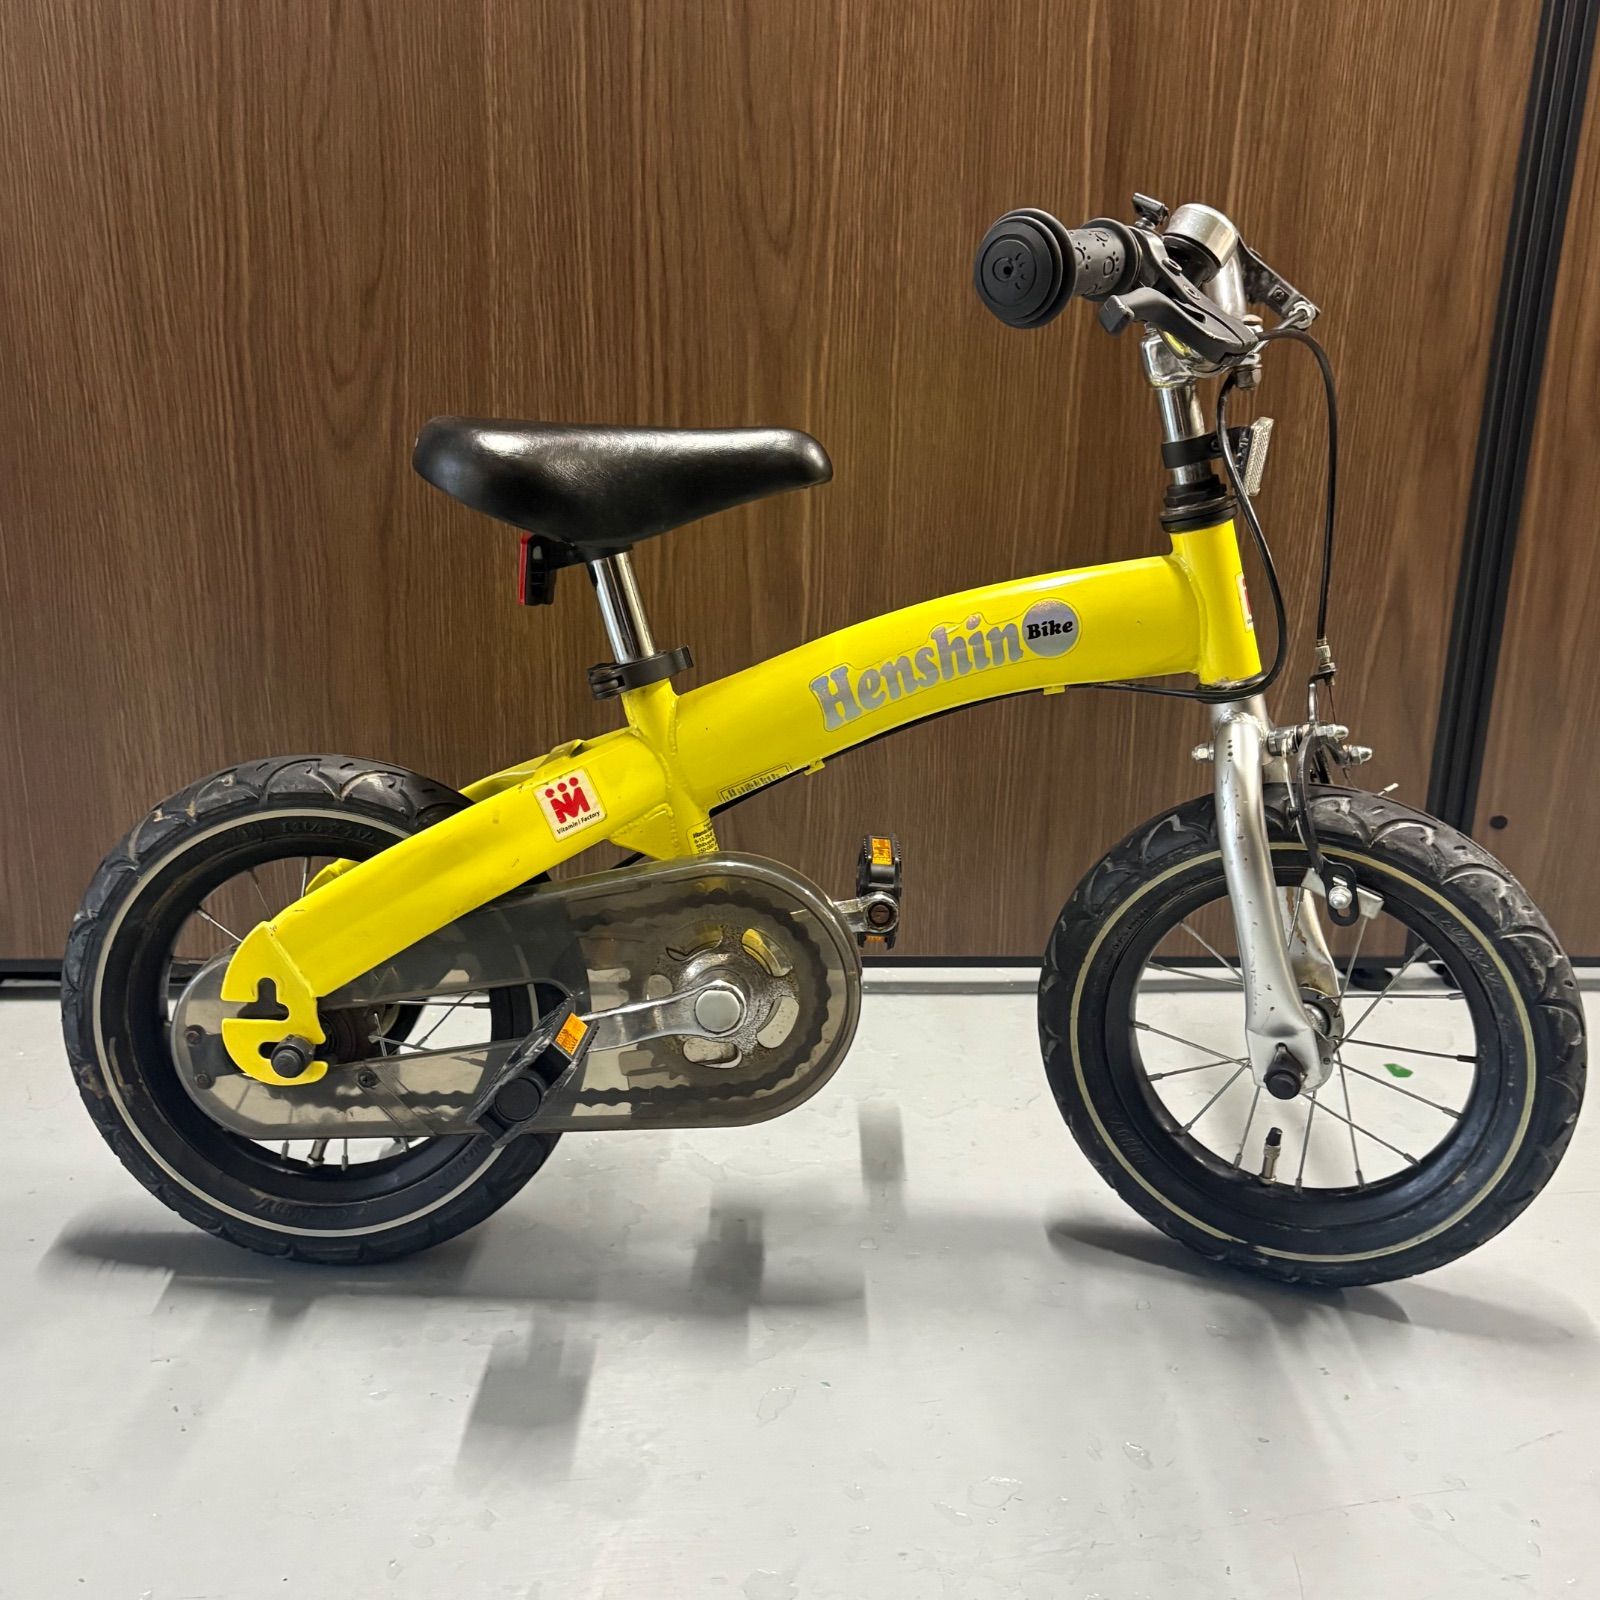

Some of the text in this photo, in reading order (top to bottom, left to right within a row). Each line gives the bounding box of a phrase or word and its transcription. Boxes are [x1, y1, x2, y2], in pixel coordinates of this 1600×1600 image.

[811, 616, 1075, 731] Henshin Bike
[556, 820, 578, 834] Vitamin
[580, 811, 600, 823] Factory
